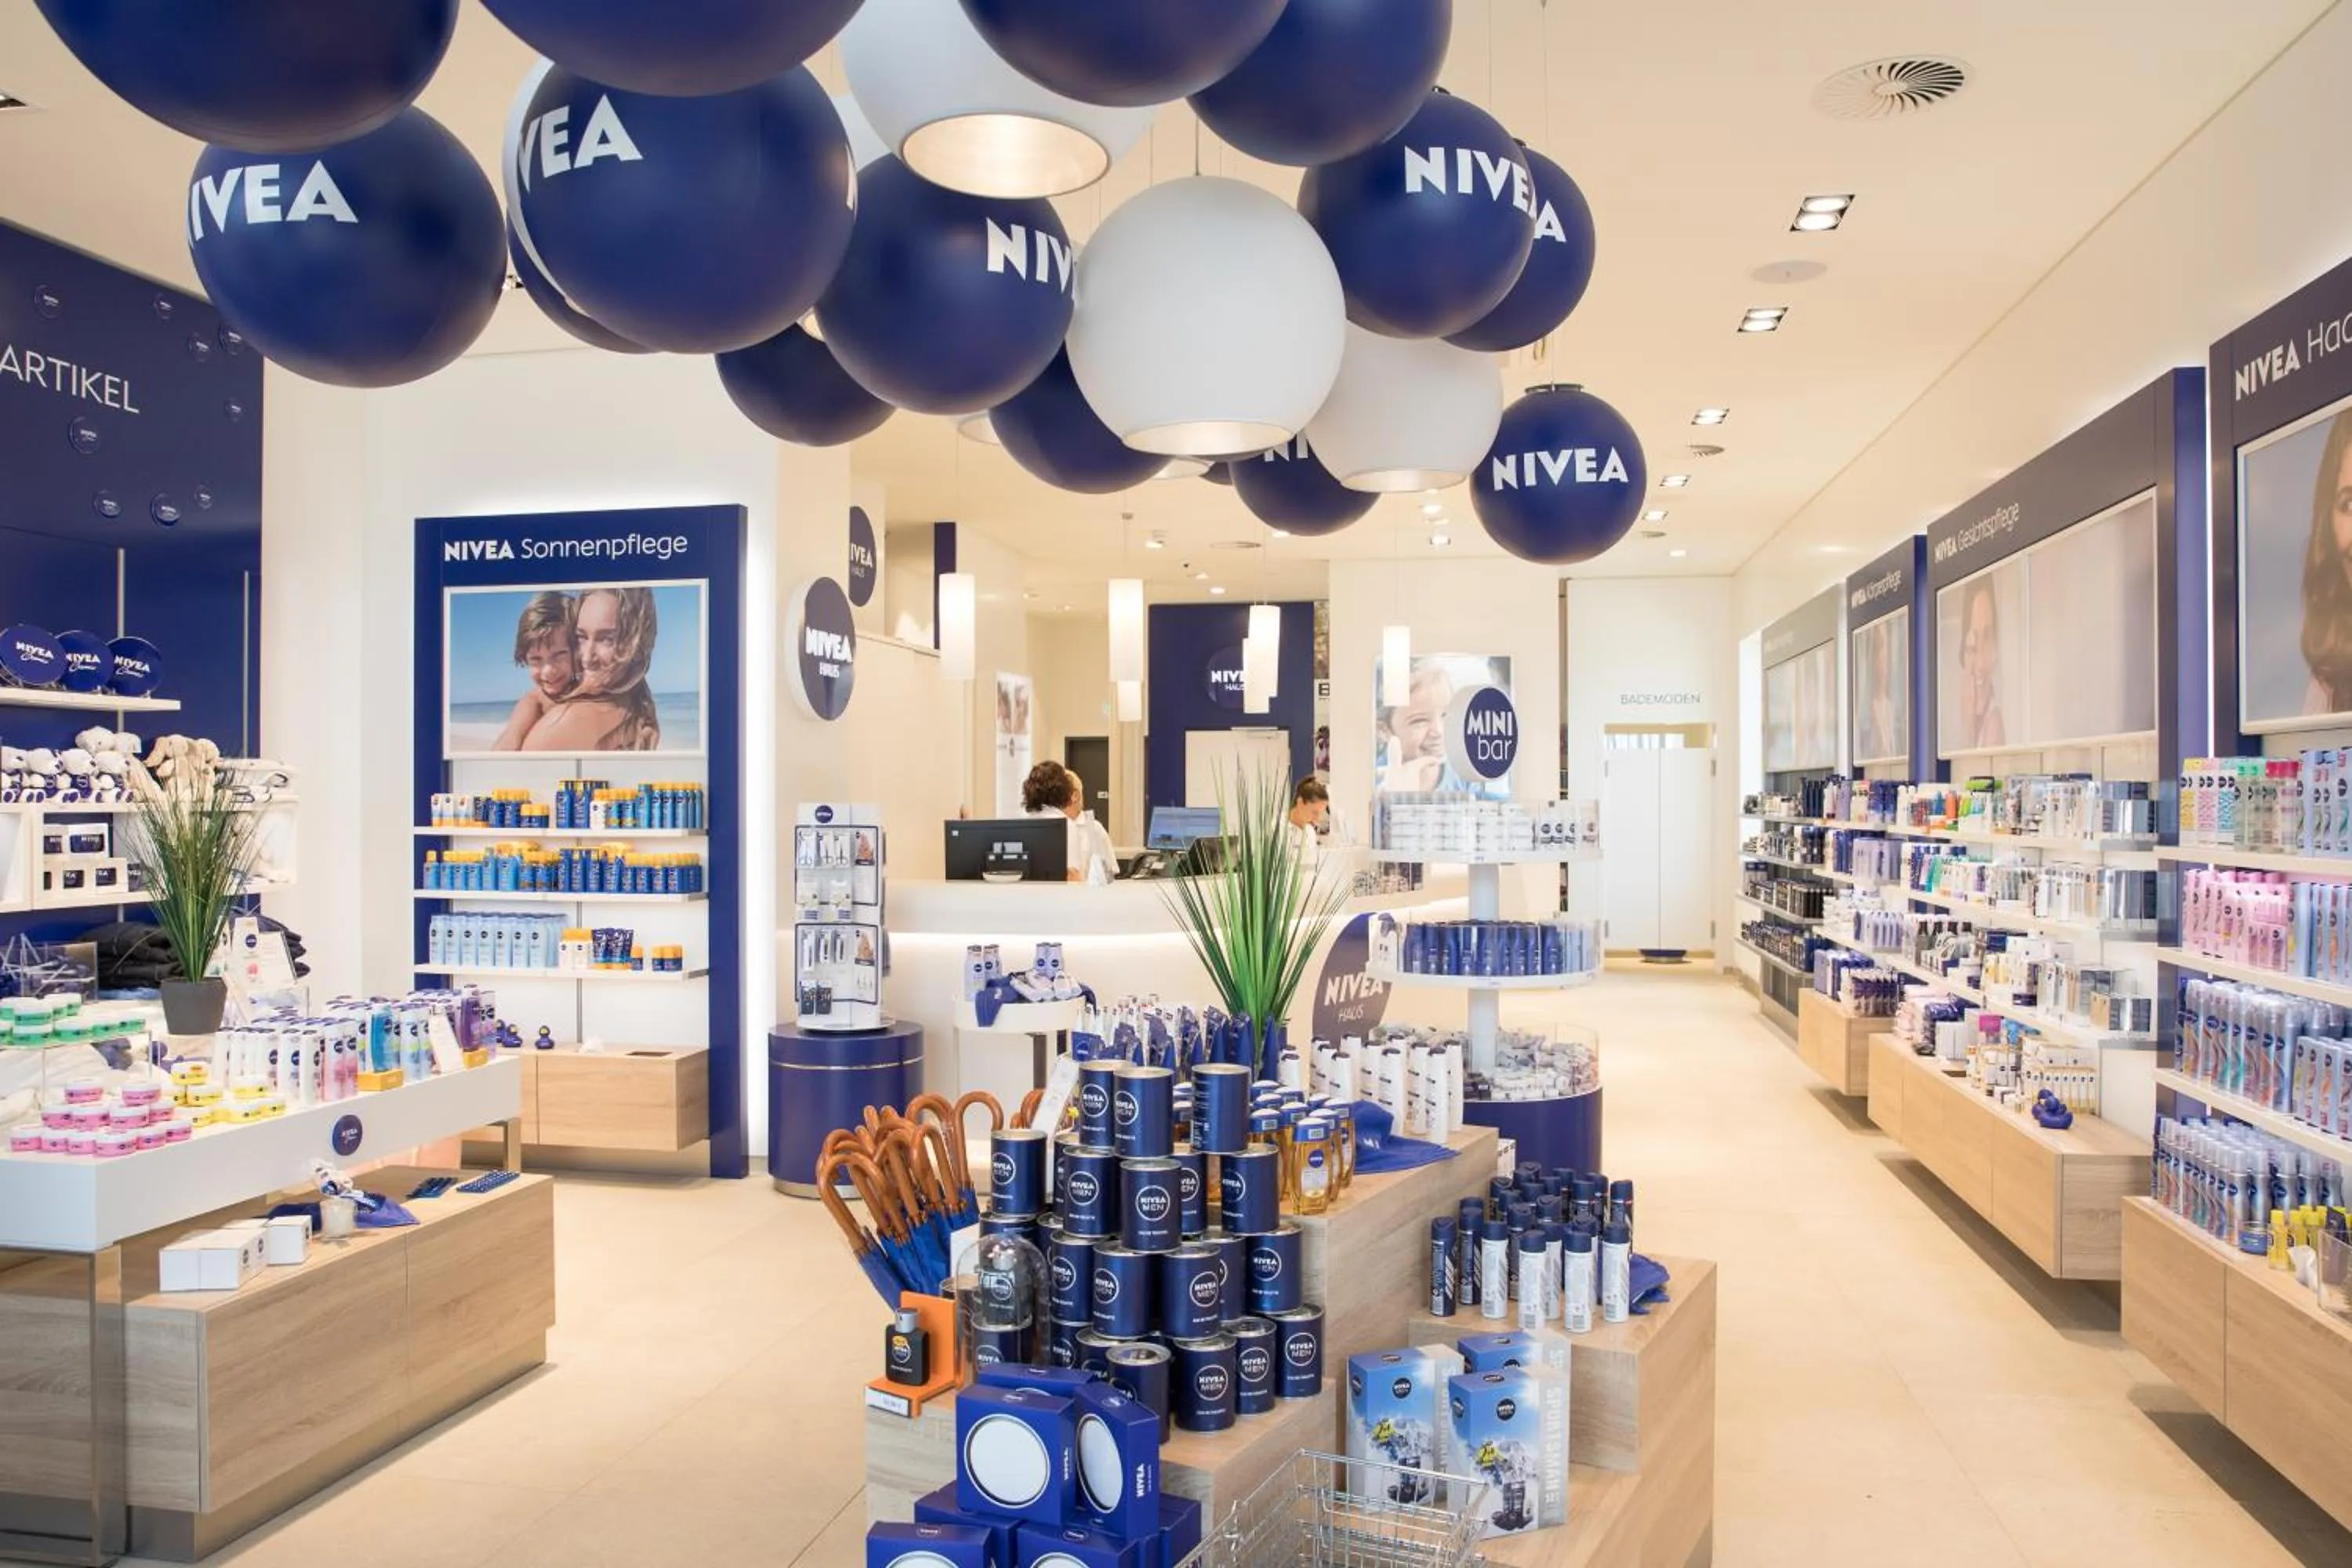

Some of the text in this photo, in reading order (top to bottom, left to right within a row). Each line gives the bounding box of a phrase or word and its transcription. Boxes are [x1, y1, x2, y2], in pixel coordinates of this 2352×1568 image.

[518, 93, 644, 194] VEA
[1404, 145, 1537, 222] NIVE
[188, 159, 358, 246] IVEA
[986, 216, 1074, 299] NIV
[2235, 338, 2301, 401] NIVEA
[1493, 445, 1629, 490] NIVEA
[445, 533, 688, 562] NIVEA Sonnenpflege
[851, 543, 873, 568] IVEA
[1934, 540, 1958, 564] NIVEA
[16, 641, 54, 660] NIVEA
[805, 626, 853, 663] NIVEA
[114, 655, 151, 673] NIVEA
[1211, 670, 1245, 683] NIV
[1467, 709, 1512, 736] MINI
[1478, 736, 1512, 760] bar
[1323, 971, 1383, 1006] NIVEA
[1071, 1181, 1094, 1190] NIVEA
[1290, 1341, 1313, 1350] NIVEA
[1242, 1357, 1267, 1366] NIVEA
[1199, 1375, 1225, 1384] NIVEA
